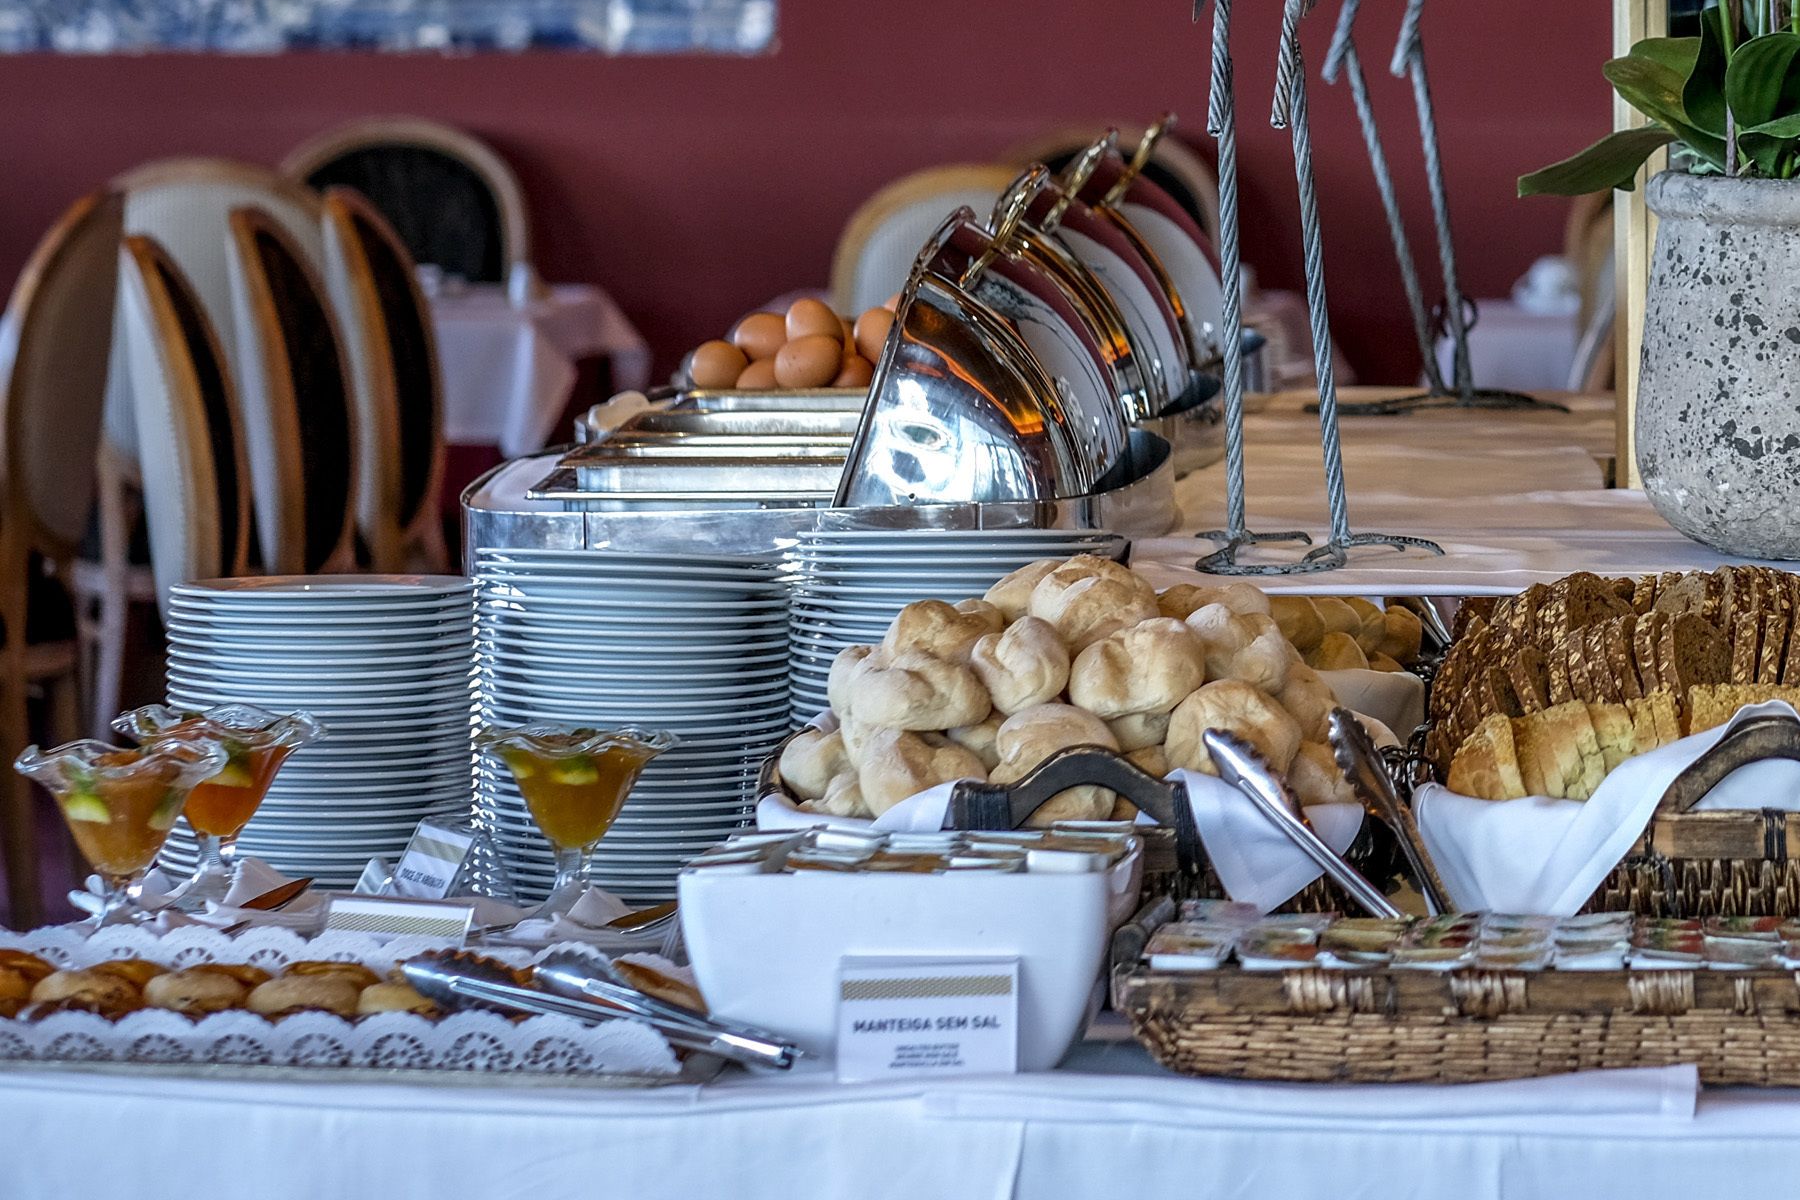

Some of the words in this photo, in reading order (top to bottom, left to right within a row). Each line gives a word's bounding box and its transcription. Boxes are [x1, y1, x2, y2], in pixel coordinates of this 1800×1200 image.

[853, 1017, 932, 1033] MANTEIGA
[936, 1015, 968, 1031] SEM
[971, 1014, 1001, 1030] SAL
